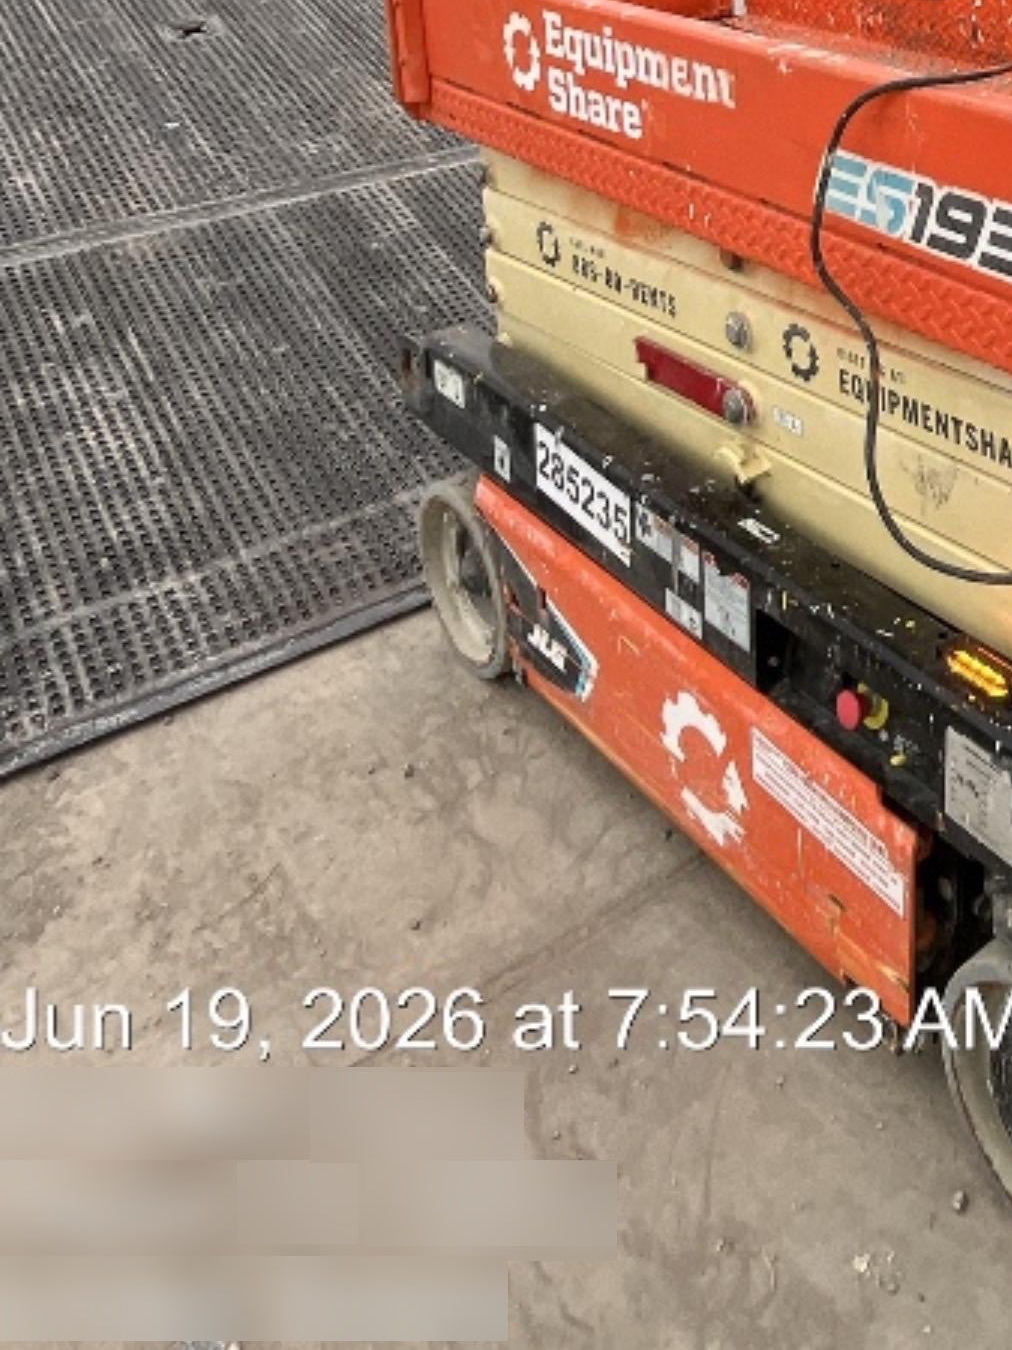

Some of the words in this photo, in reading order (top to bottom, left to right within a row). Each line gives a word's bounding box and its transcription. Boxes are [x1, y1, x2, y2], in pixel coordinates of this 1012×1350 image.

[542, 9, 736, 109] Equipment
[548, 66, 642, 139] Share
[538, 440, 628, 542] 285235
